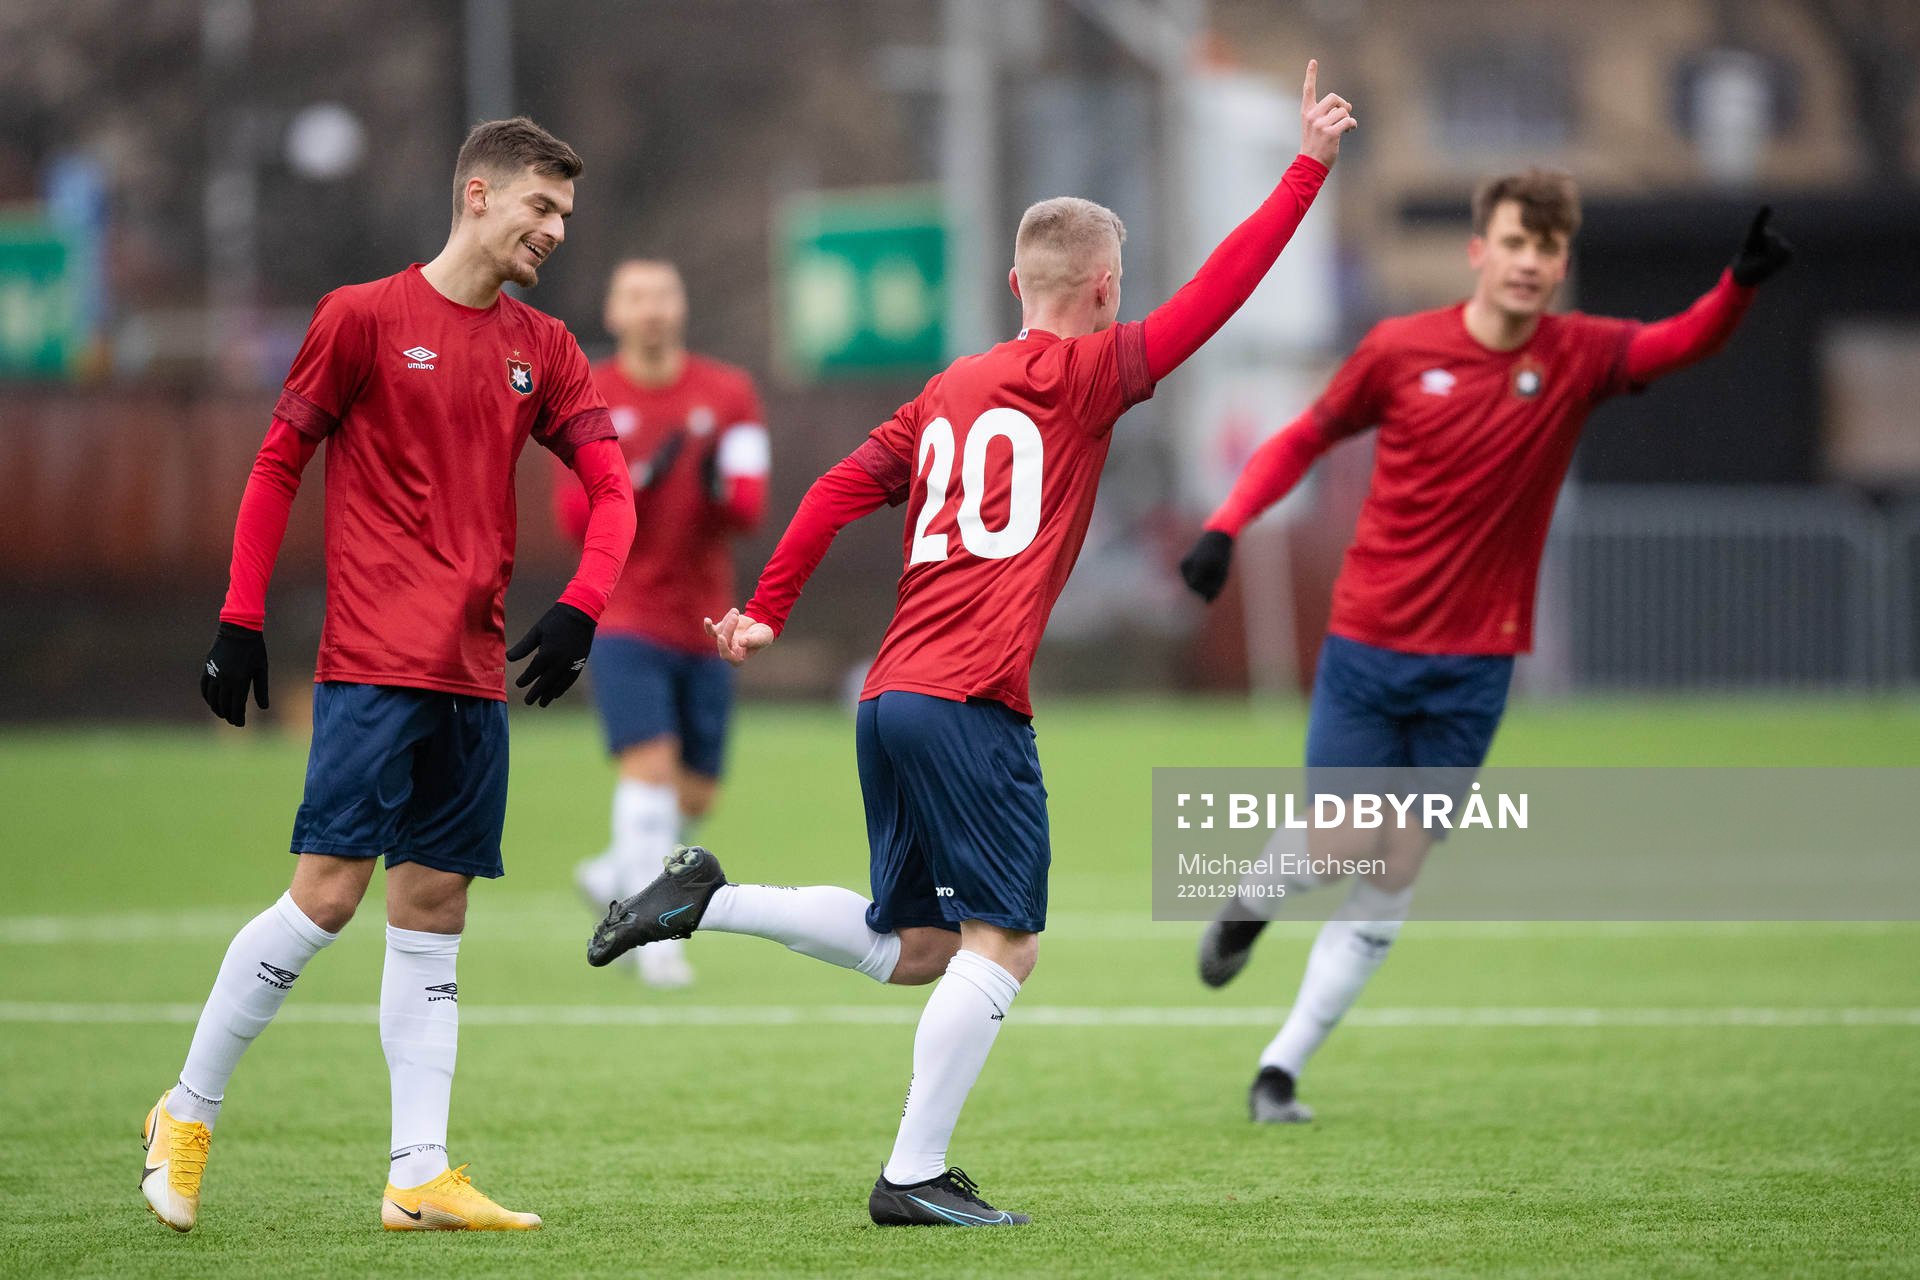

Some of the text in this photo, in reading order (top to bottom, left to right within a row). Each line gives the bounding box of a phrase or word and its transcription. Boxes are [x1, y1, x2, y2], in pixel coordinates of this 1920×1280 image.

[407, 361, 435, 371] umbro
[909, 407, 1044, 567] 20
[256, 972, 293, 990] umbr
[427, 994, 457, 1002] umb
